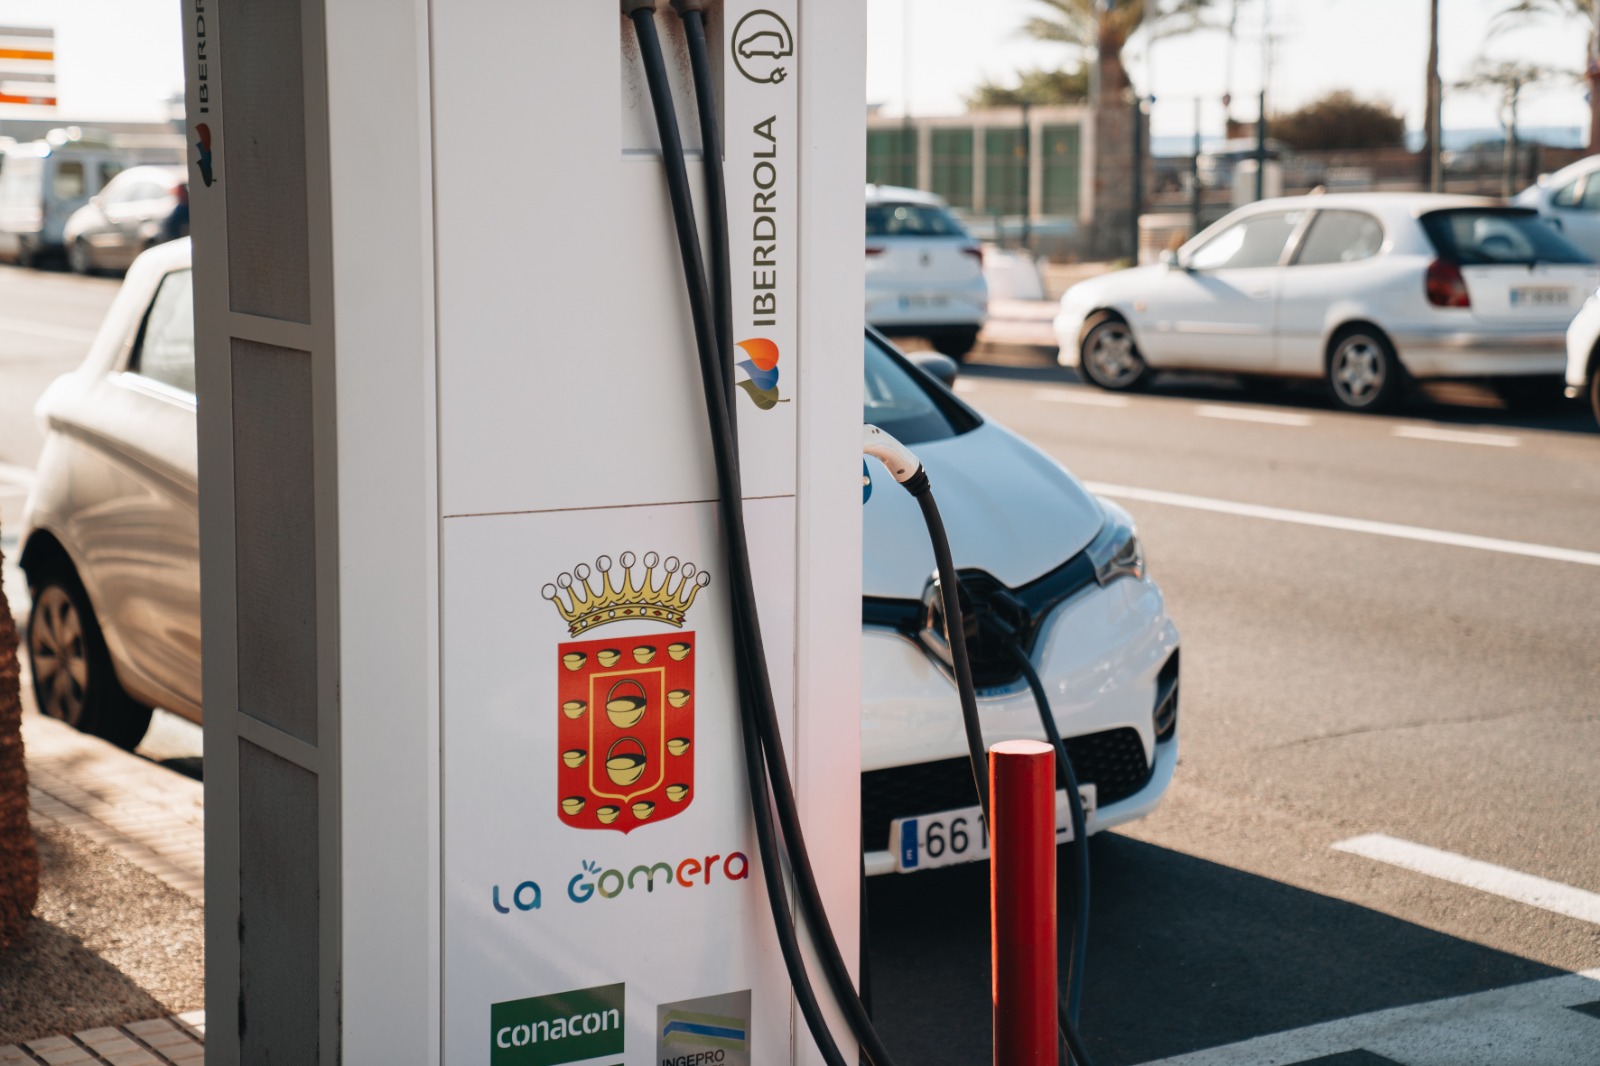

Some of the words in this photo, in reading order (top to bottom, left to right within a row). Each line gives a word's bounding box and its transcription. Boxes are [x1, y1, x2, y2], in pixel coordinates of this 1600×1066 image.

[753, 115, 777, 326] IBERDROLA
[926, 814, 988, 858] 661
[567, 852, 749, 904] Gomera
[496, 1008, 620, 1049] conacon
[662, 1049, 725, 1066] INGEPRO
